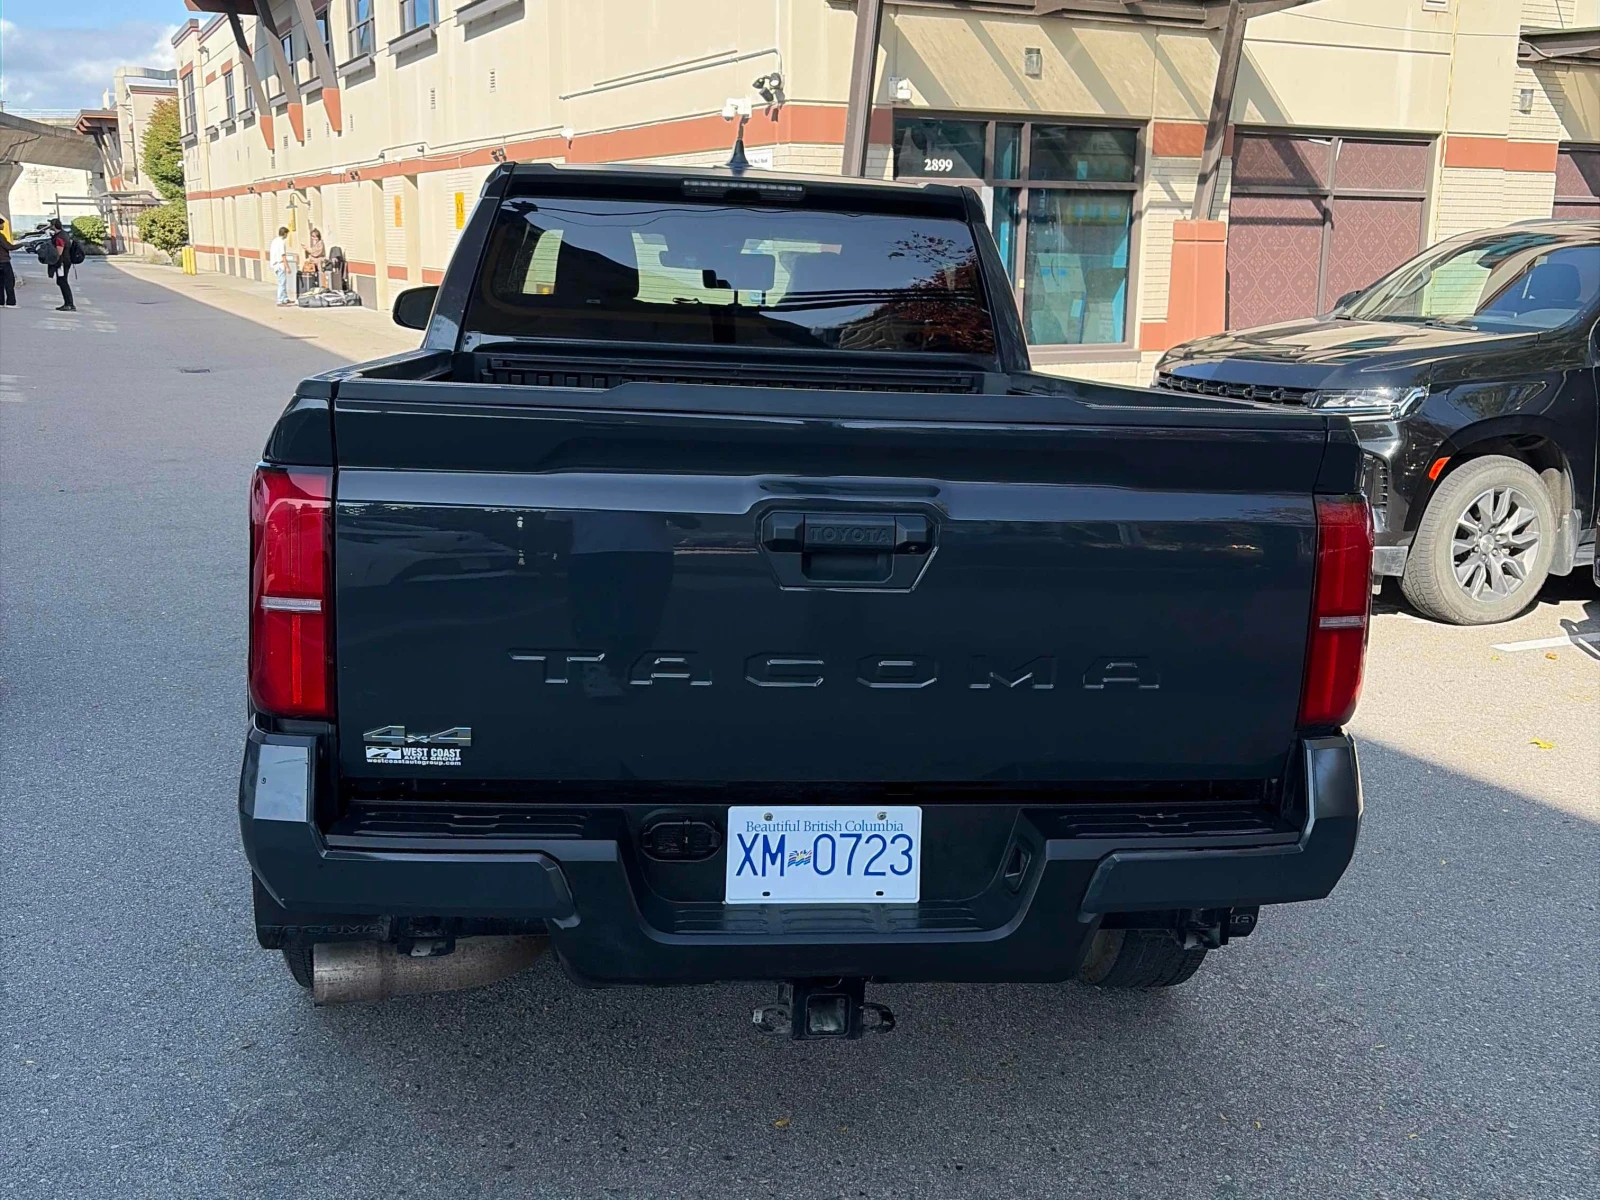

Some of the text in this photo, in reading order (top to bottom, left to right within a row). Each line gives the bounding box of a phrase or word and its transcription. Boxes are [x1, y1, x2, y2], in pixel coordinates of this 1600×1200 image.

[924, 158, 953, 172] 2899
[810, 526, 890, 542] TOYOTA
[508, 648, 1160, 689] TACOMA
[402, 747, 461, 758] WEST COAST
[366, 758, 462, 766] westcoastautogroup.com
[746, 819, 904, 832] Beautiful British Columbia
[736, 833, 914, 877] XM 0723
